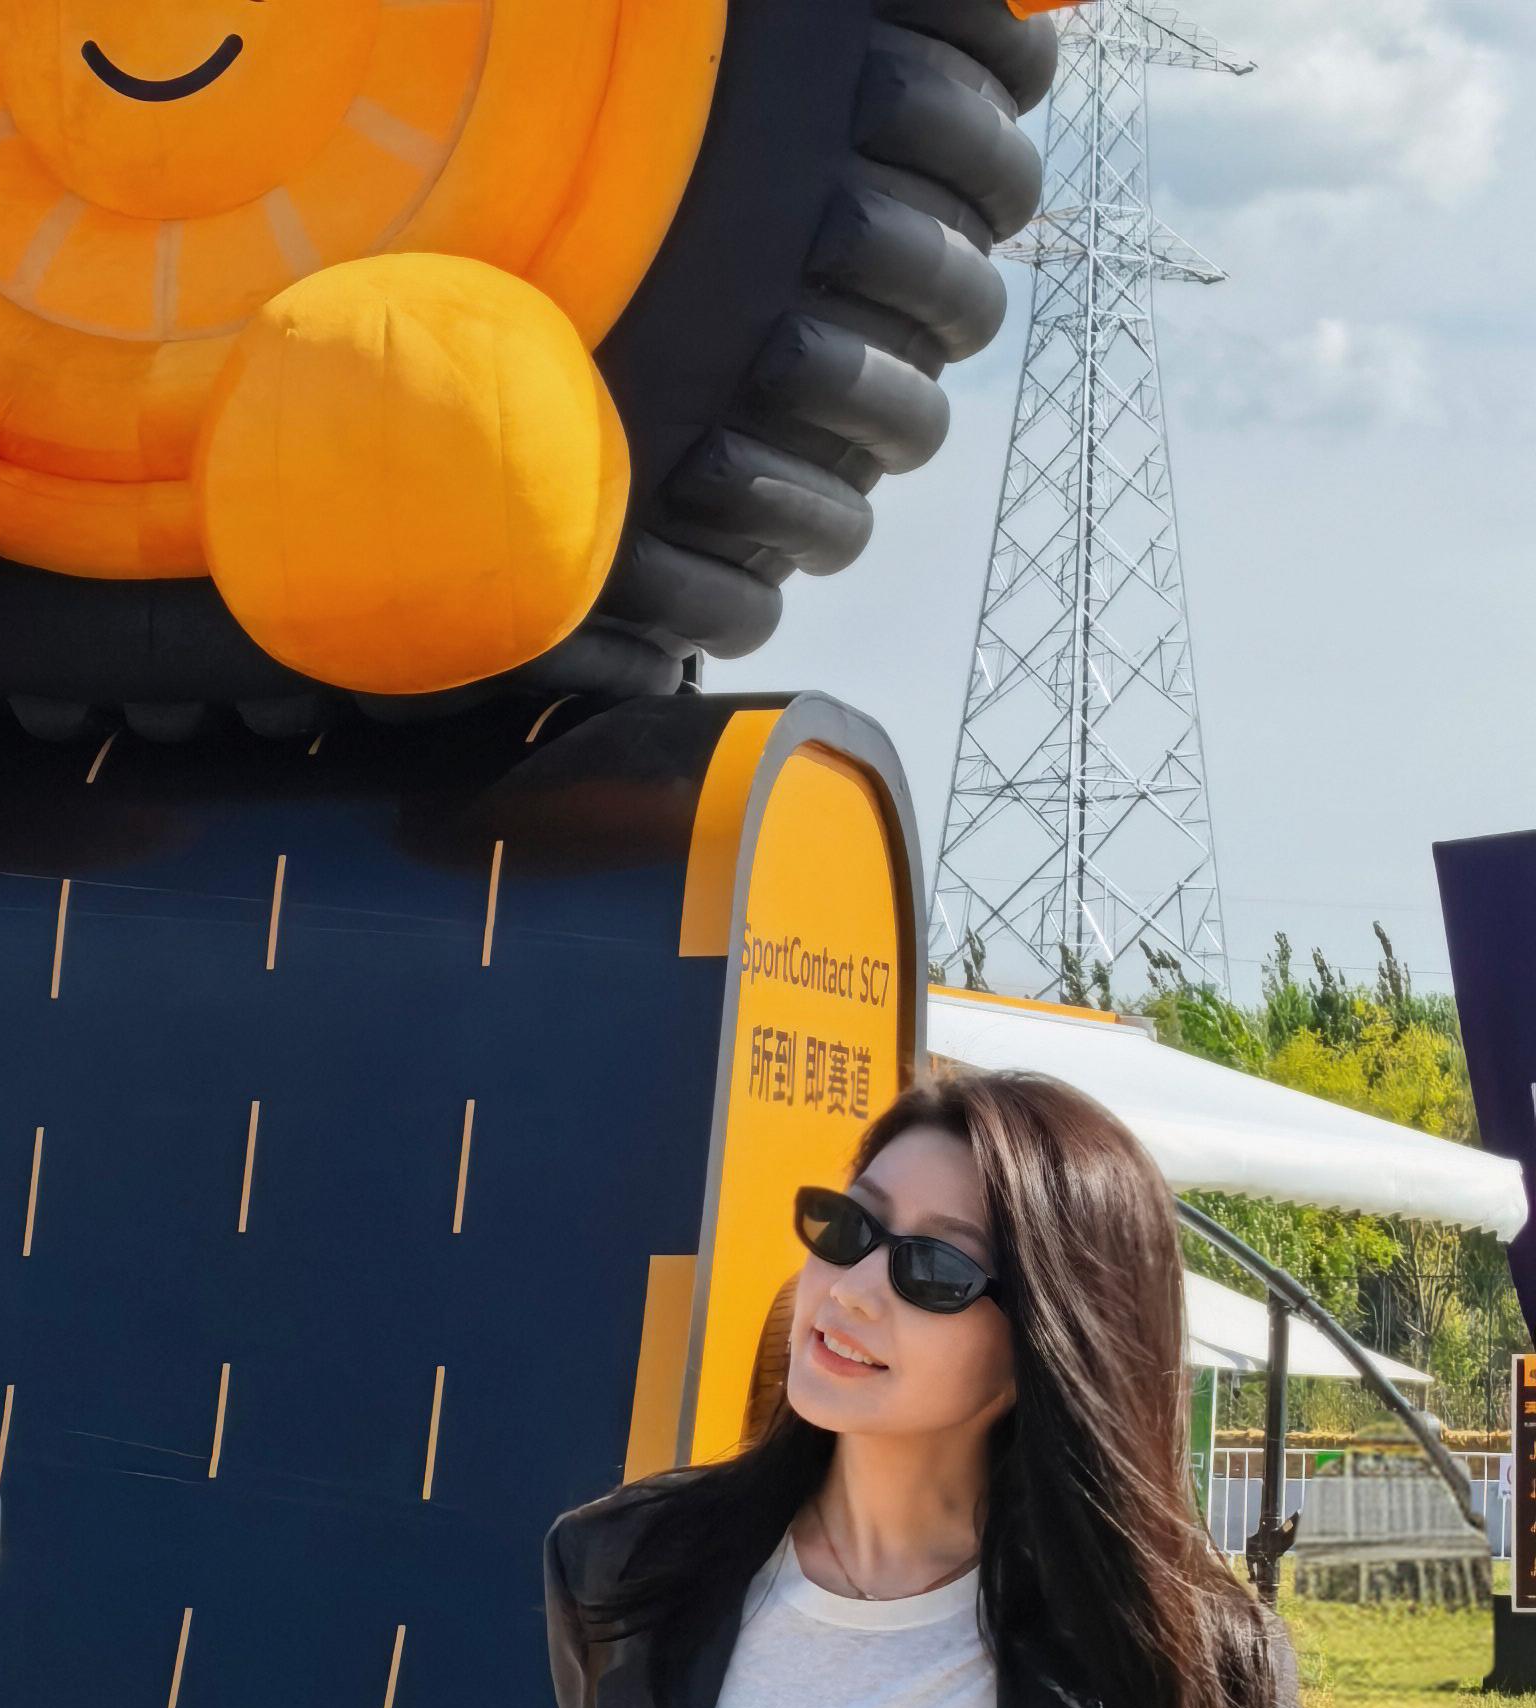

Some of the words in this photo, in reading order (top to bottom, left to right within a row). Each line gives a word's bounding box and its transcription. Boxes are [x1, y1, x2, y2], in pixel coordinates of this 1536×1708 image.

[741, 922, 855, 1000] SportContact
[859, 956, 890, 1008] SC7
[748, 1024, 797, 1106] 所到
[804, 1036, 872, 1120] 即赛道
